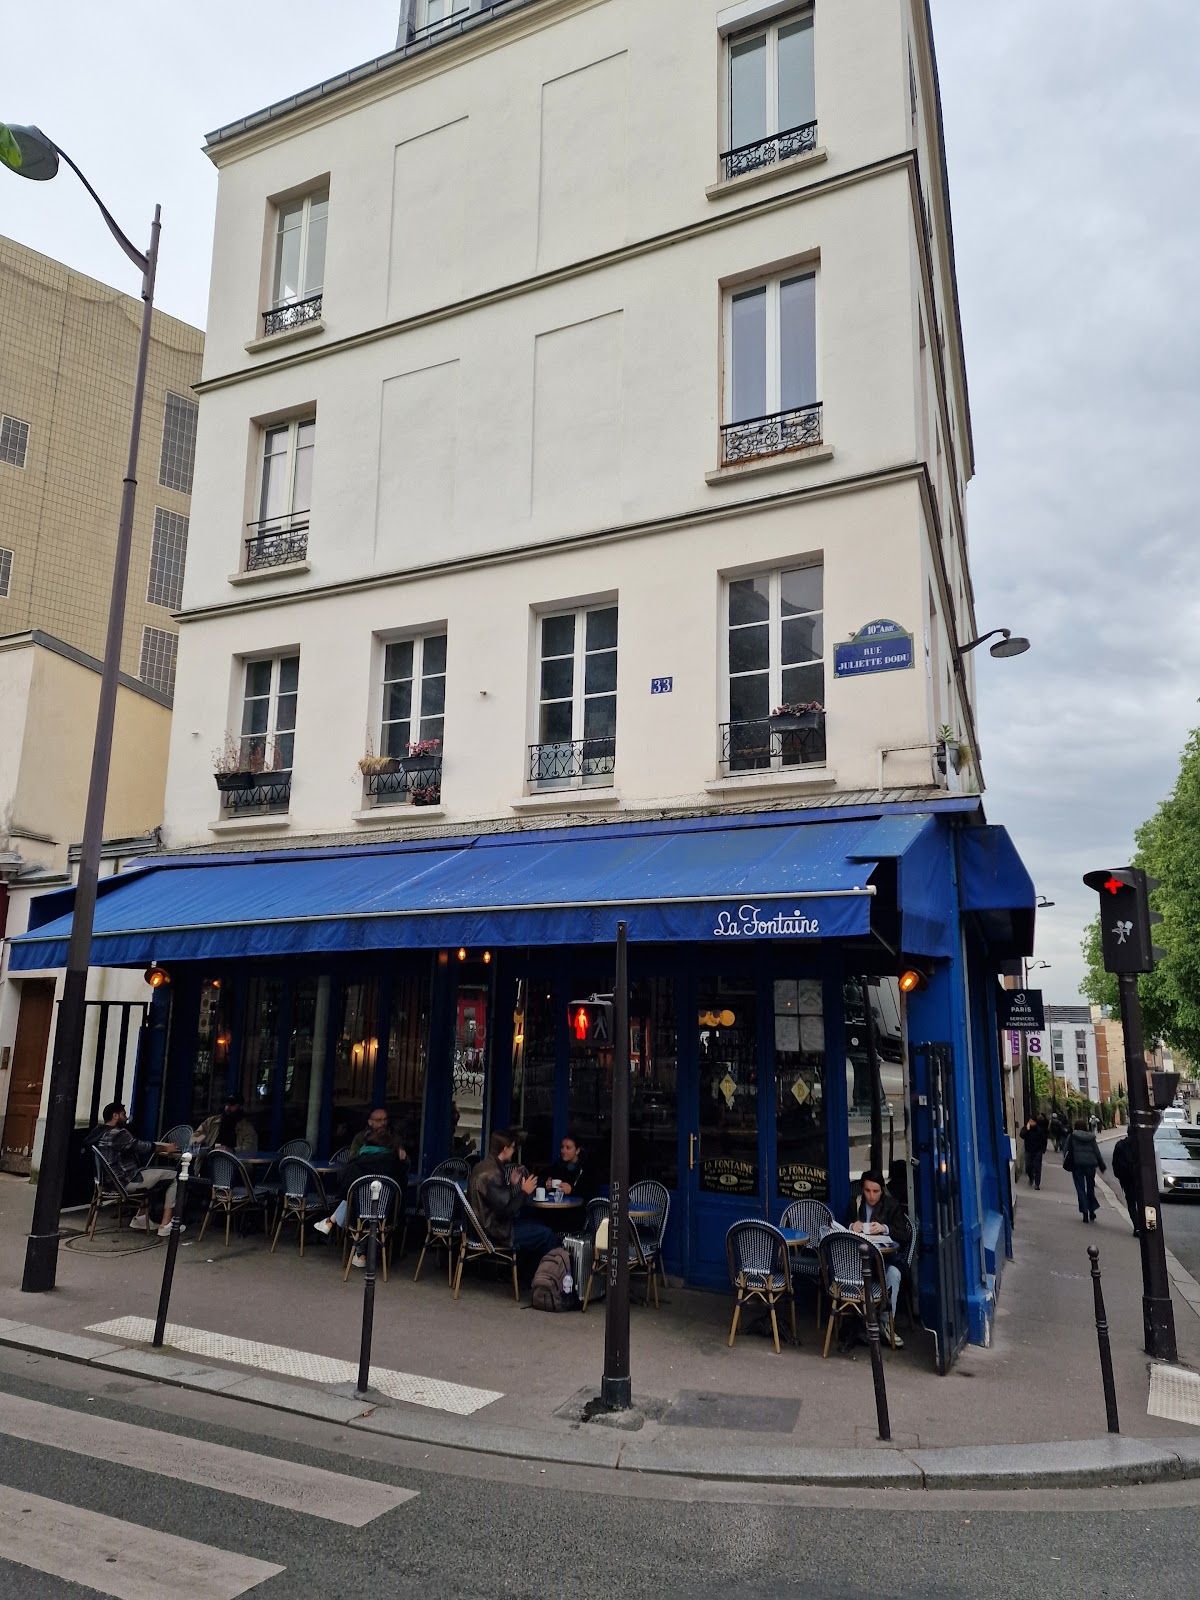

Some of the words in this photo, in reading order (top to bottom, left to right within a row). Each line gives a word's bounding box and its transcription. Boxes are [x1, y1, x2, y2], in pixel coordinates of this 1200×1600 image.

[863, 646, 883, 656] RUE
[838, 657, 883, 671] JULIETTE
[884, 653, 910, 664] DODU
[653, 679, 671, 693] 33
[713, 911, 741, 936] La
[738, 904, 820, 936] Fontaine
[1029, 1037, 1042, 1053] 8
[714, 1159, 754, 1175] FONTAINE
[778, 1167, 787, 1177] LA
[788, 1165, 827, 1181] FONTAINE
